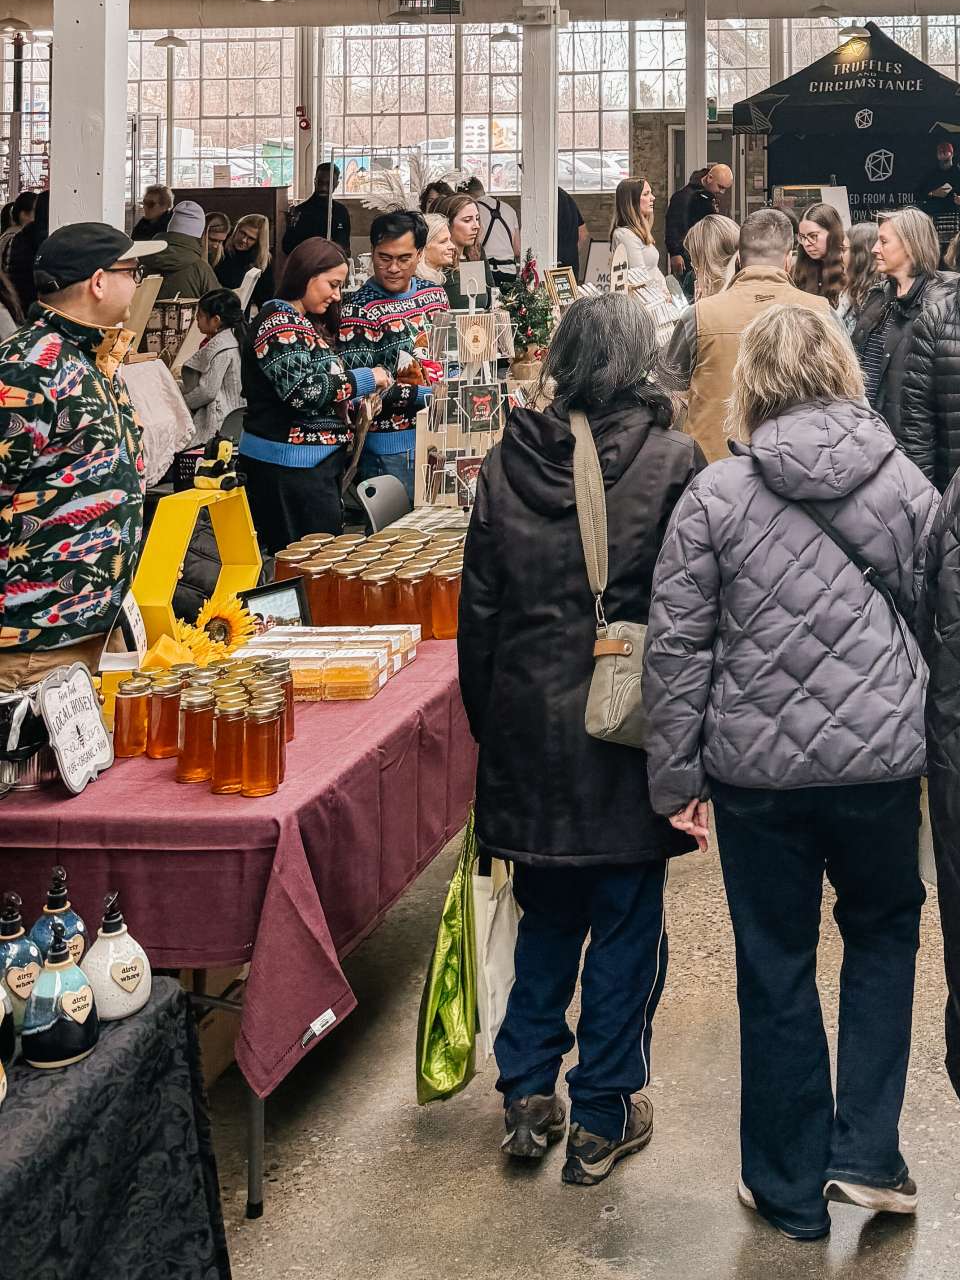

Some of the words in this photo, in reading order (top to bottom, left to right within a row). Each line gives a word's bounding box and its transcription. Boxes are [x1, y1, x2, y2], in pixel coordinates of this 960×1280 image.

[833, 59, 902, 75] TRUFFLES
[809, 78, 924, 93] CIRCUMSTANCE
[849, 192, 860, 205] ED
[863, 192, 886, 204] FROM
[889, 192, 895, 204] A
[898, 192, 917, 204] TRU
[380, 300, 415, 315] MERRY
[257, 315, 289, 337] ERRY
[52, 705, 73, 736] LOCAL
[71, 693, 93, 716] HONEY
[16, 971, 33, 981] dirty
[122, 964, 138, 975] dirty
[120, 972, 140, 982] whore
[72, 993, 88, 1005] dirty
[71, 1002, 90, 1014] whore
